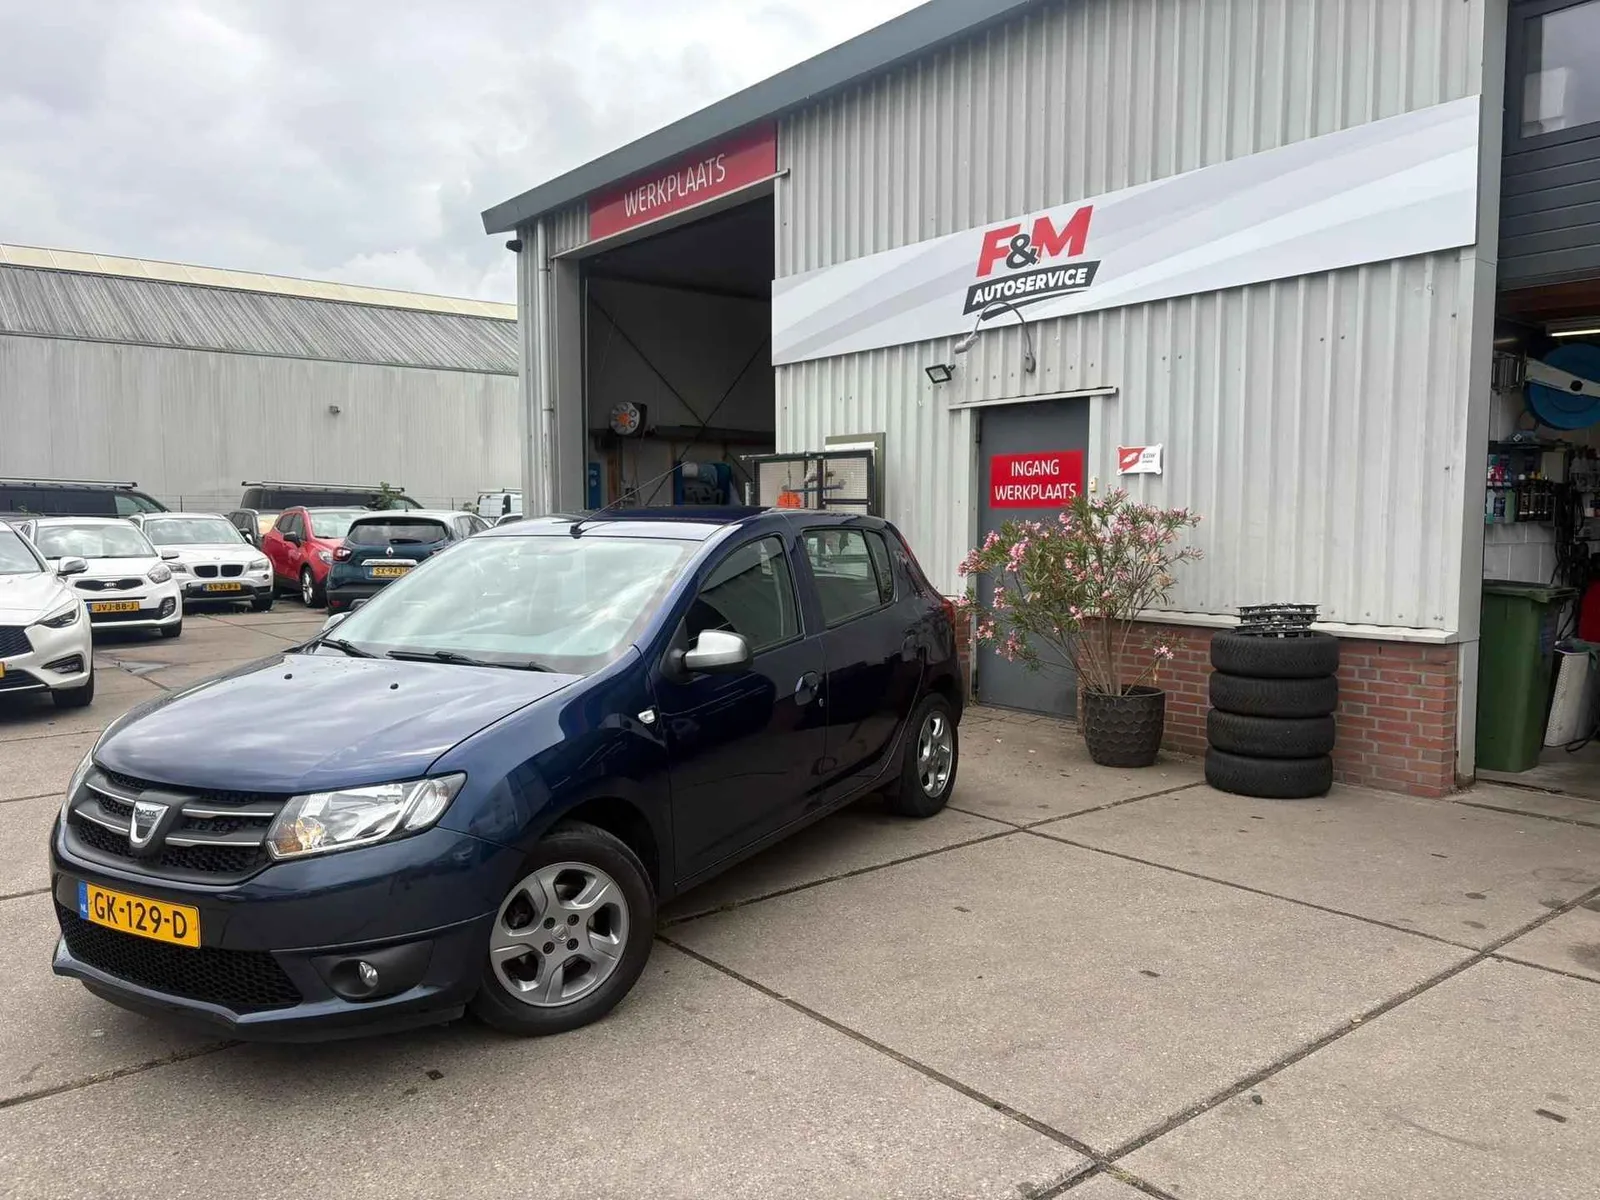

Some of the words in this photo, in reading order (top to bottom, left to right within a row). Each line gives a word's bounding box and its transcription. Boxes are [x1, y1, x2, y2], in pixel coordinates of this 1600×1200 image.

[624, 153, 726, 217] WERKPLAATS
[976, 205, 1093, 277] F&M
[972, 267, 1088, 305] AUTOSERVICE
[1011, 459, 1060, 477] INGANG
[995, 483, 1077, 501] WERKPLAATS
[94, 892, 187, 939] GK-129-D
